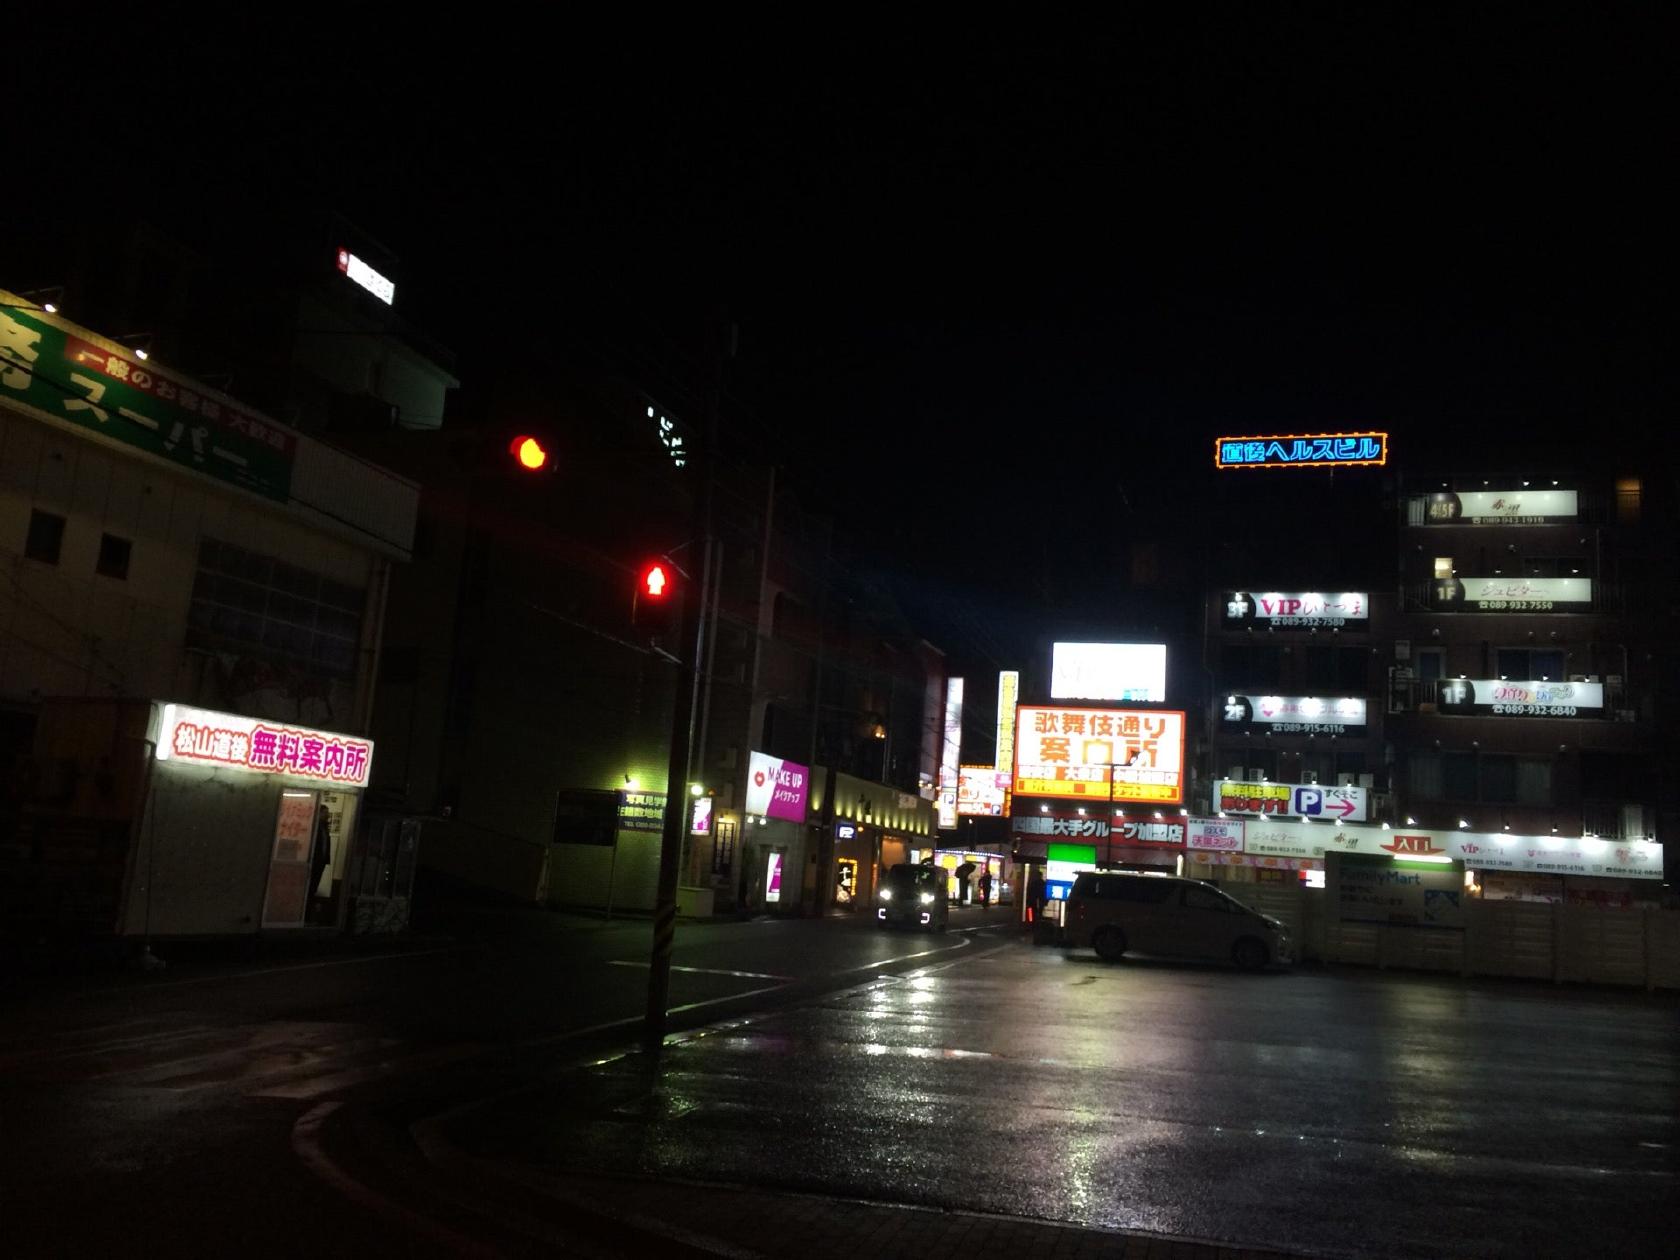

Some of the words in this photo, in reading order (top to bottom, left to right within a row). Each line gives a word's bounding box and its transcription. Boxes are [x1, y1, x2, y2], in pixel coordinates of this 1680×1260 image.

[1437, 587, 1458, 601] 1F
[1227, 602, 1249, 618] 3F
[1442, 686, 1467, 704] 1F
[1225, 704, 1246, 721] 2F
[1034, 711, 1167, 740] 歌舞伎通り
[174, 723, 248, 762] 松山道後
[250, 727, 369, 782] 無料案内所
[768, 766, 791, 787] MAKE
[792, 772, 803, 789] UP
[774, 789, 801, 804] メイクアップ
[1300, 790, 1319, 812] P
[1324, 788, 1359, 800] すぐそこ
